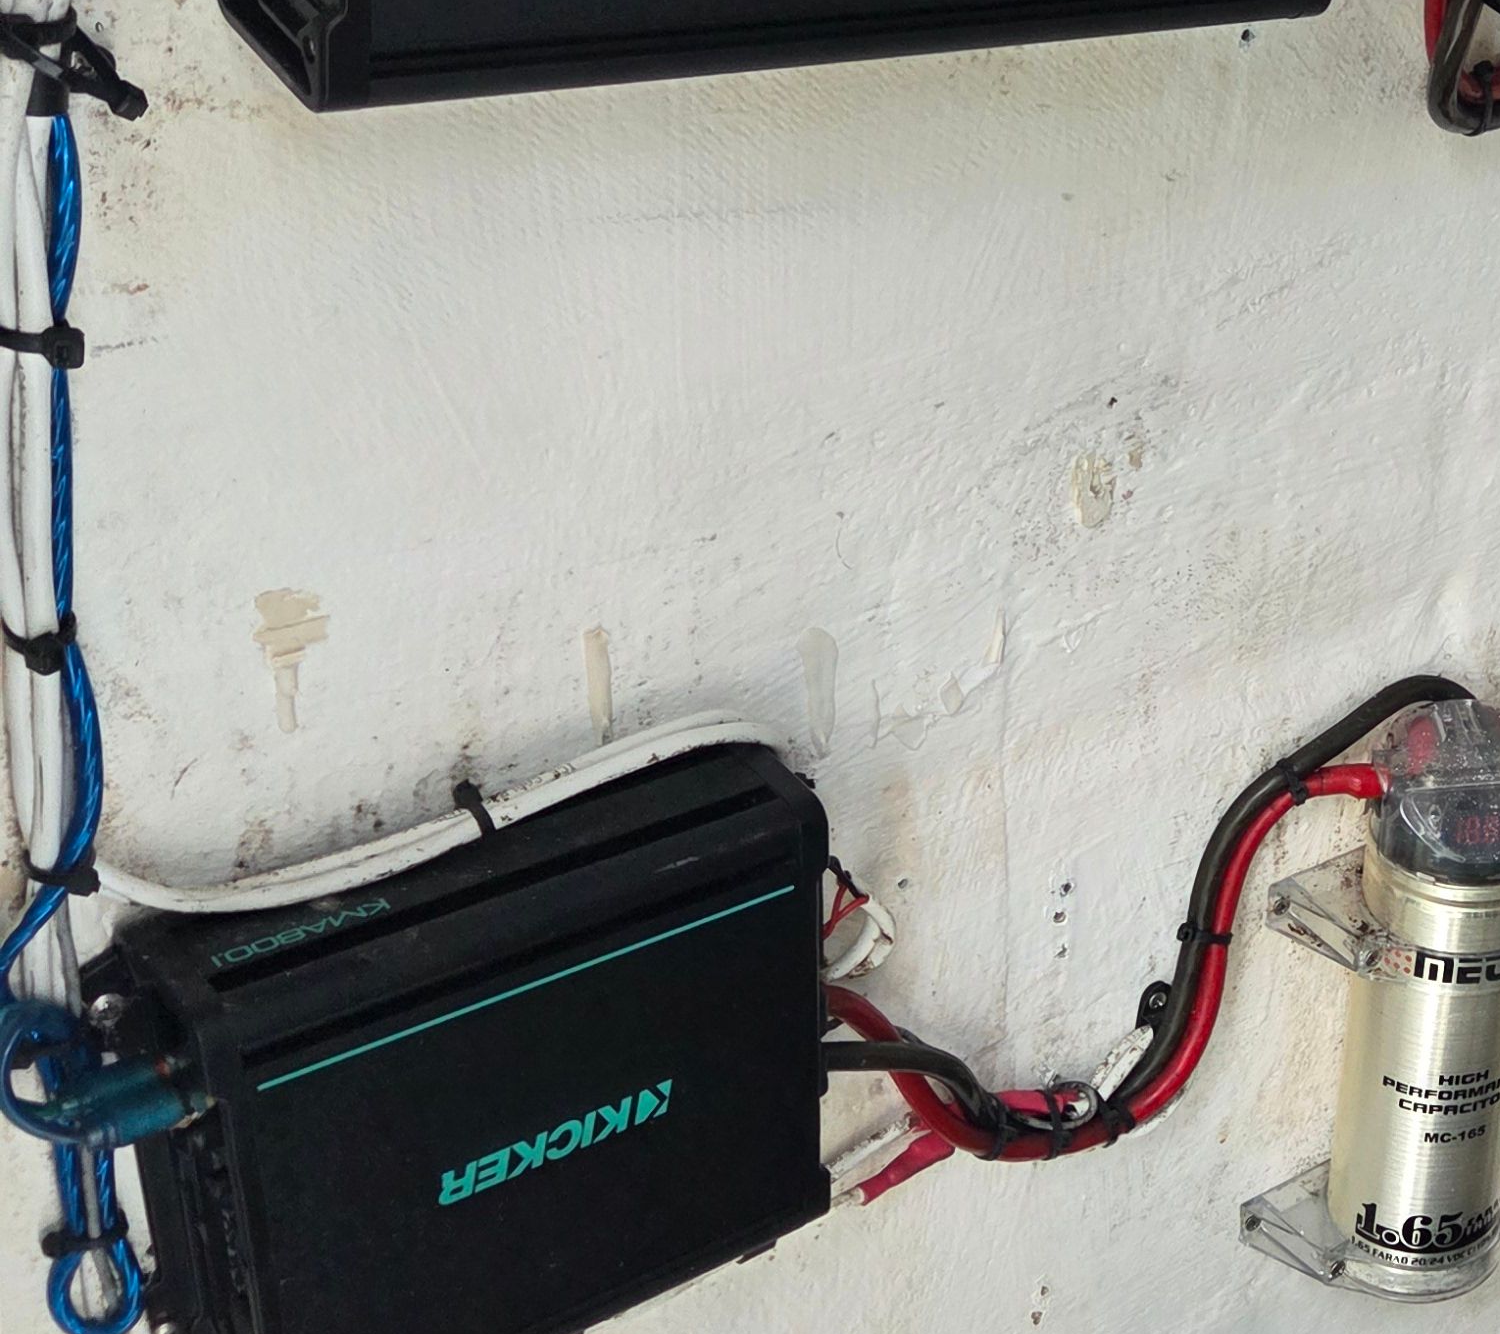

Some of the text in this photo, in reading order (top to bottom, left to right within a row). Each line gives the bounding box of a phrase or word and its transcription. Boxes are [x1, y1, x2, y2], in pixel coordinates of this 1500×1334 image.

[1438, 1069, 1490, 1087] HIGH
[1424, 1124, 1487, 1144] MC-165
[437, 1095, 636, 1206] KICKER
